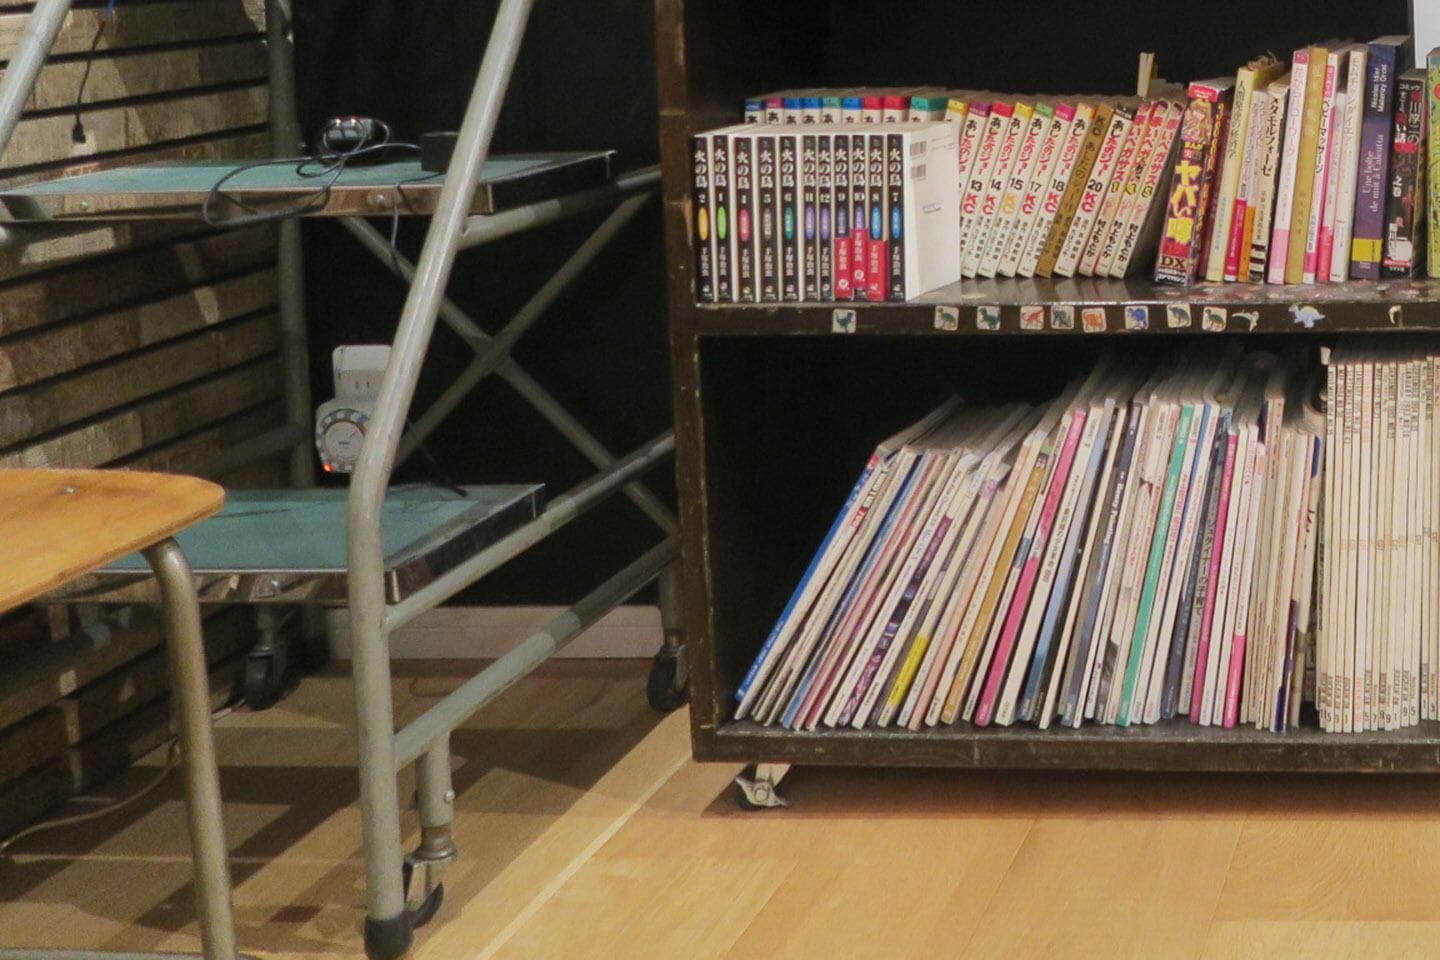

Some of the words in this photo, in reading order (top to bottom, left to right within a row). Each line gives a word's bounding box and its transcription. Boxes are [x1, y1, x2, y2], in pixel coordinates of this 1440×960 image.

[979, 117, 1001, 176] あしたのジョー
[998, 118, 1021, 176] あしたのジョー
[1018, 118, 1042, 176] あしたのジョー
[1037, 119, 1061, 177] あしたのジョー
[1060, 117, 1086, 176] あしたのジョー
[1097, 116, 1124, 177] あしたのジョー
[1261, 98, 1278, 177] メタモルフォーゼ
[695, 150, 708, 188] 火の鳥
[714, 148, 727, 188] 火の鳥
[737, 151, 750, 189] 火の鳥
[760, 150, 773, 189] 火の鳥
[782, 149, 794, 187] 火の鳥
[803, 149, 816, 187] 火の鳥
[819, 149, 831, 188] 火の鳥
[834, 148, 848, 187] 火の鳥
[852, 148, 866, 187] 火の鳥
[870, 149, 883, 187] 火の鳥
[889, 148, 901, 187] 火の鳥
[970, 179, 983, 192] 13
[989, 179, 1002, 192] 14
[1009, 178, 1024, 191] 15
[1029, 180, 1042, 193] 17
[1051, 179, 1065, 192] 18
[1087, 178, 1103, 193] 20
[1160, 256, 1186, 267] DX
